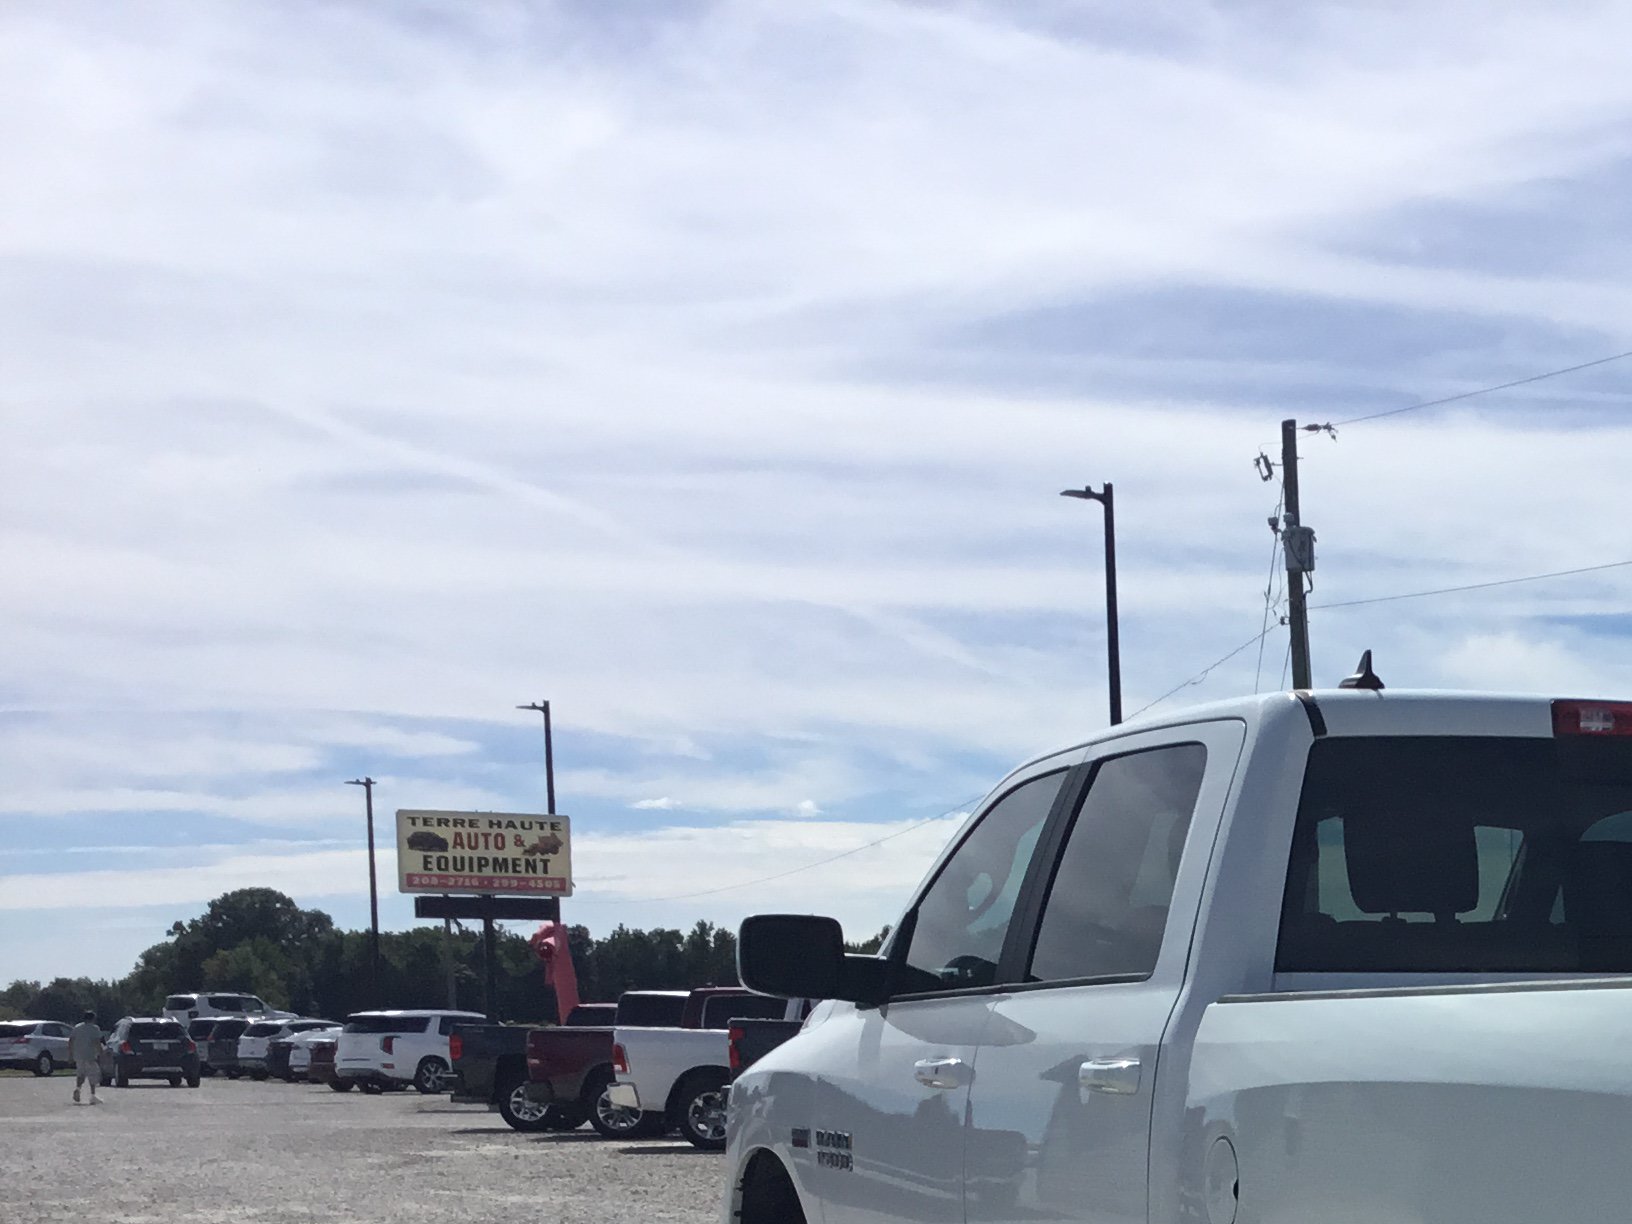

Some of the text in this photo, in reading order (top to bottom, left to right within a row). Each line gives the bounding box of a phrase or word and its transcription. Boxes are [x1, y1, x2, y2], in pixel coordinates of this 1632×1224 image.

[407, 816, 562, 832] TERRE HAUTE
[452, 831, 527, 851] AUTO &
[422, 855, 551, 875] EQUIPMENT
